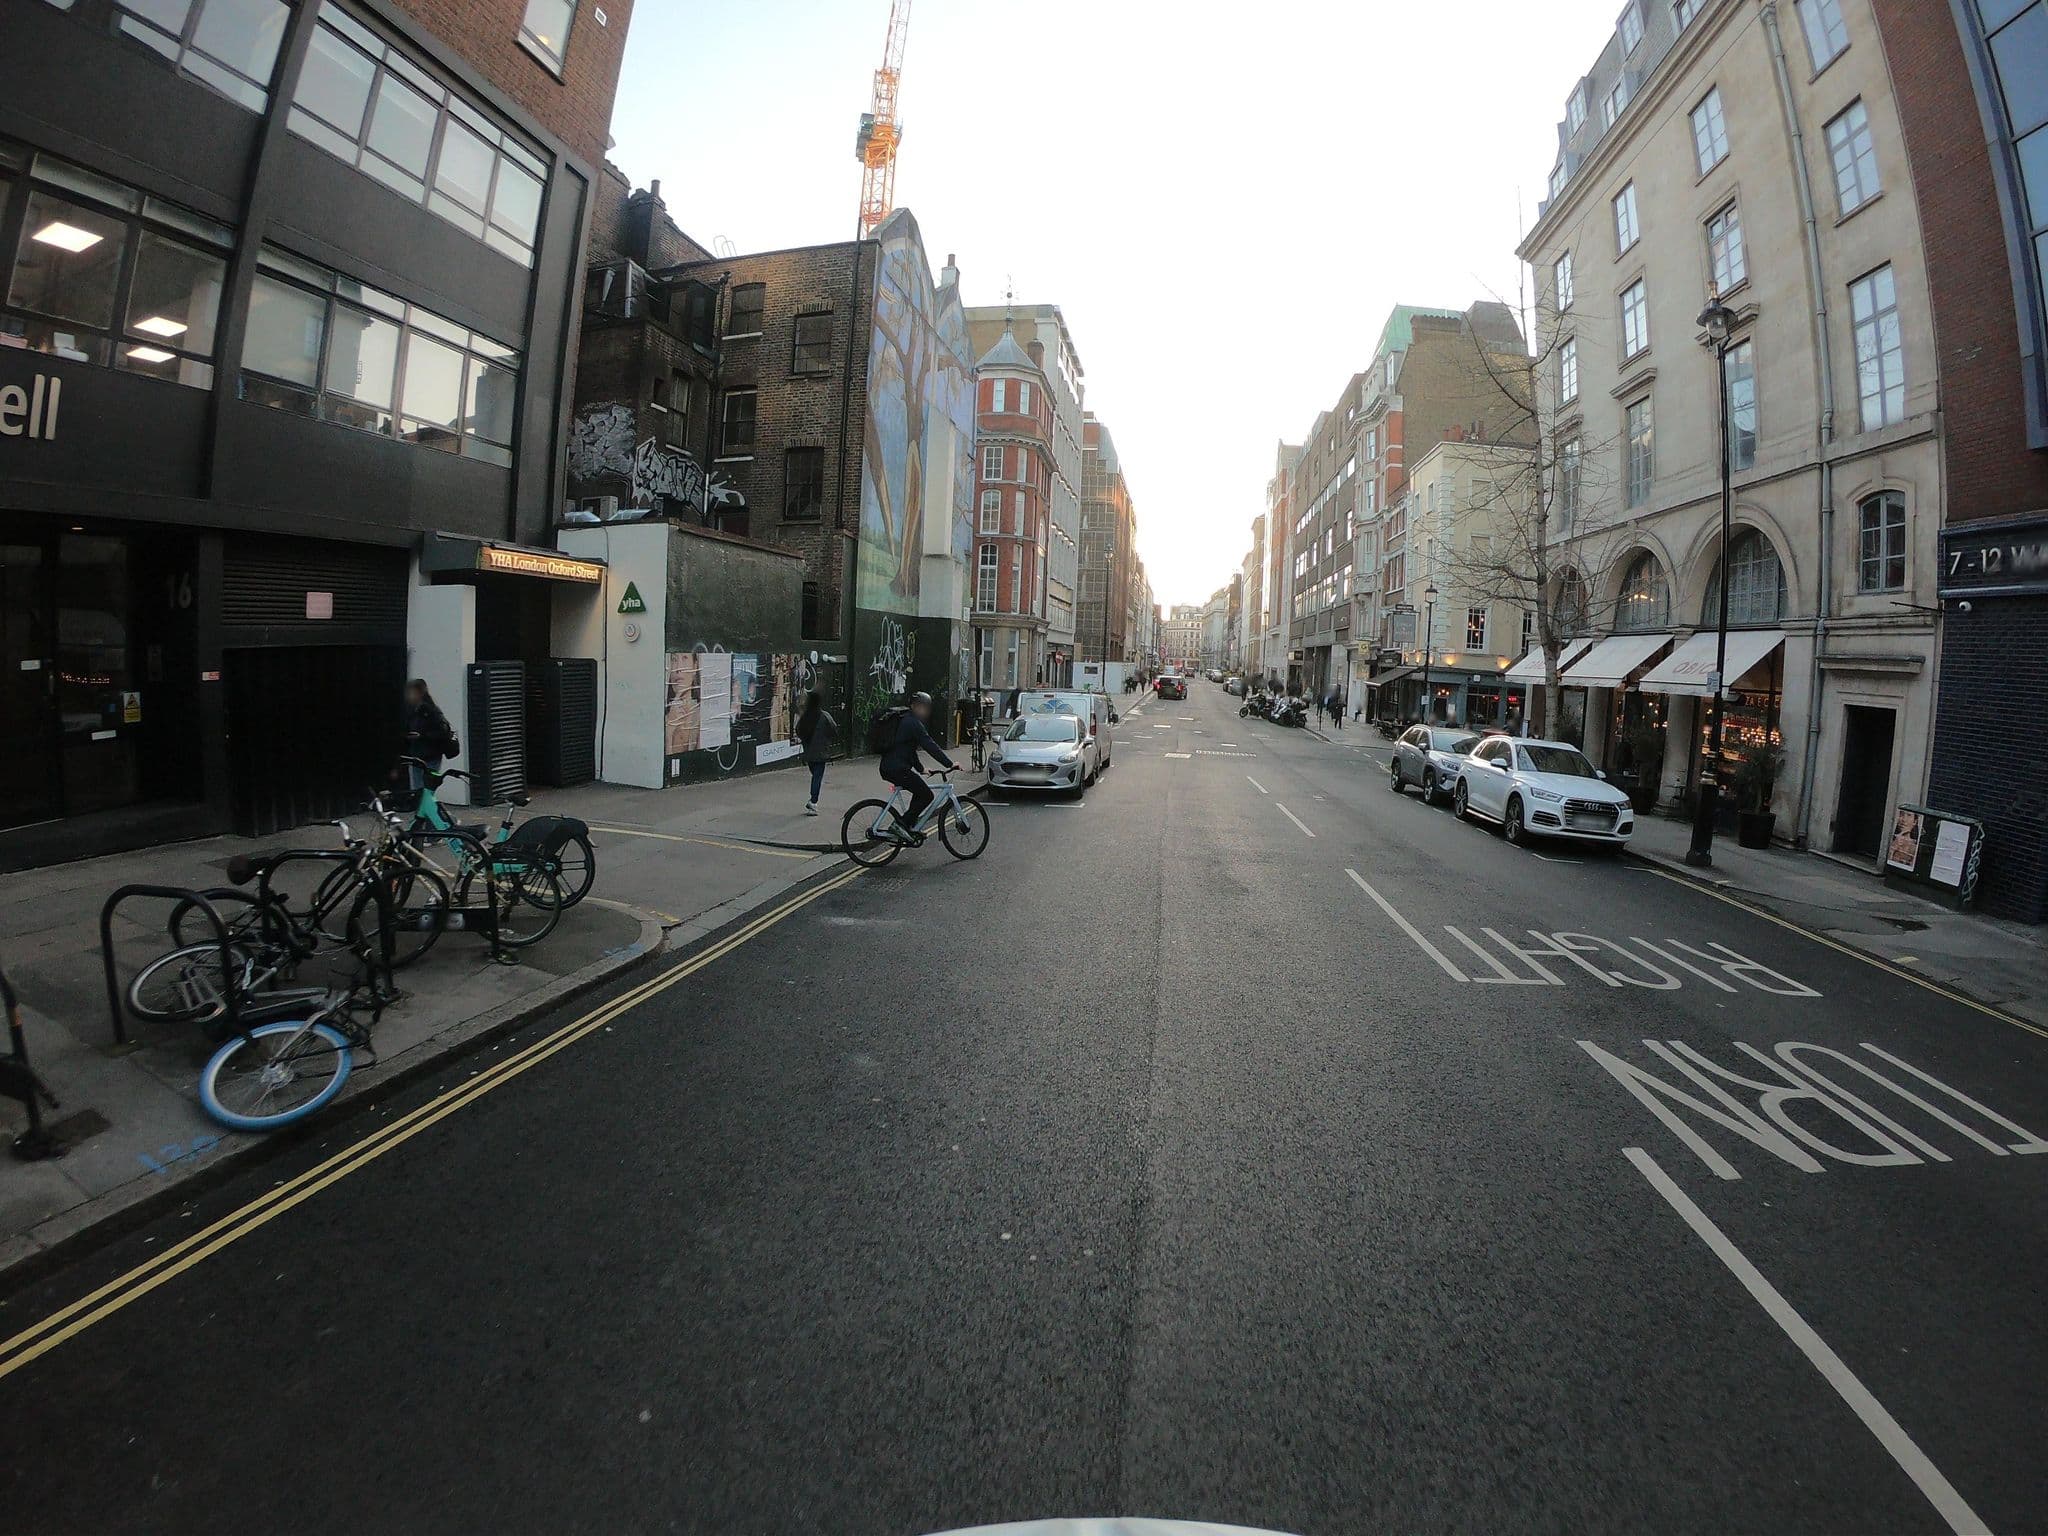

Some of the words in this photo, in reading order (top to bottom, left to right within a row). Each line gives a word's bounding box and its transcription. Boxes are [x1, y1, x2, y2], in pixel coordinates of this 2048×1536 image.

[490, 552, 513, 567] YHA
[513, 557, 548, 574] London
[548, 561, 577, 577] Oxford
[577, 565, 600, 580] Street
[622, 597, 641, 611] yha
[1443, 925, 1822, 997] RIGHT
[1575, 1039, 2048, 1181] TURN
